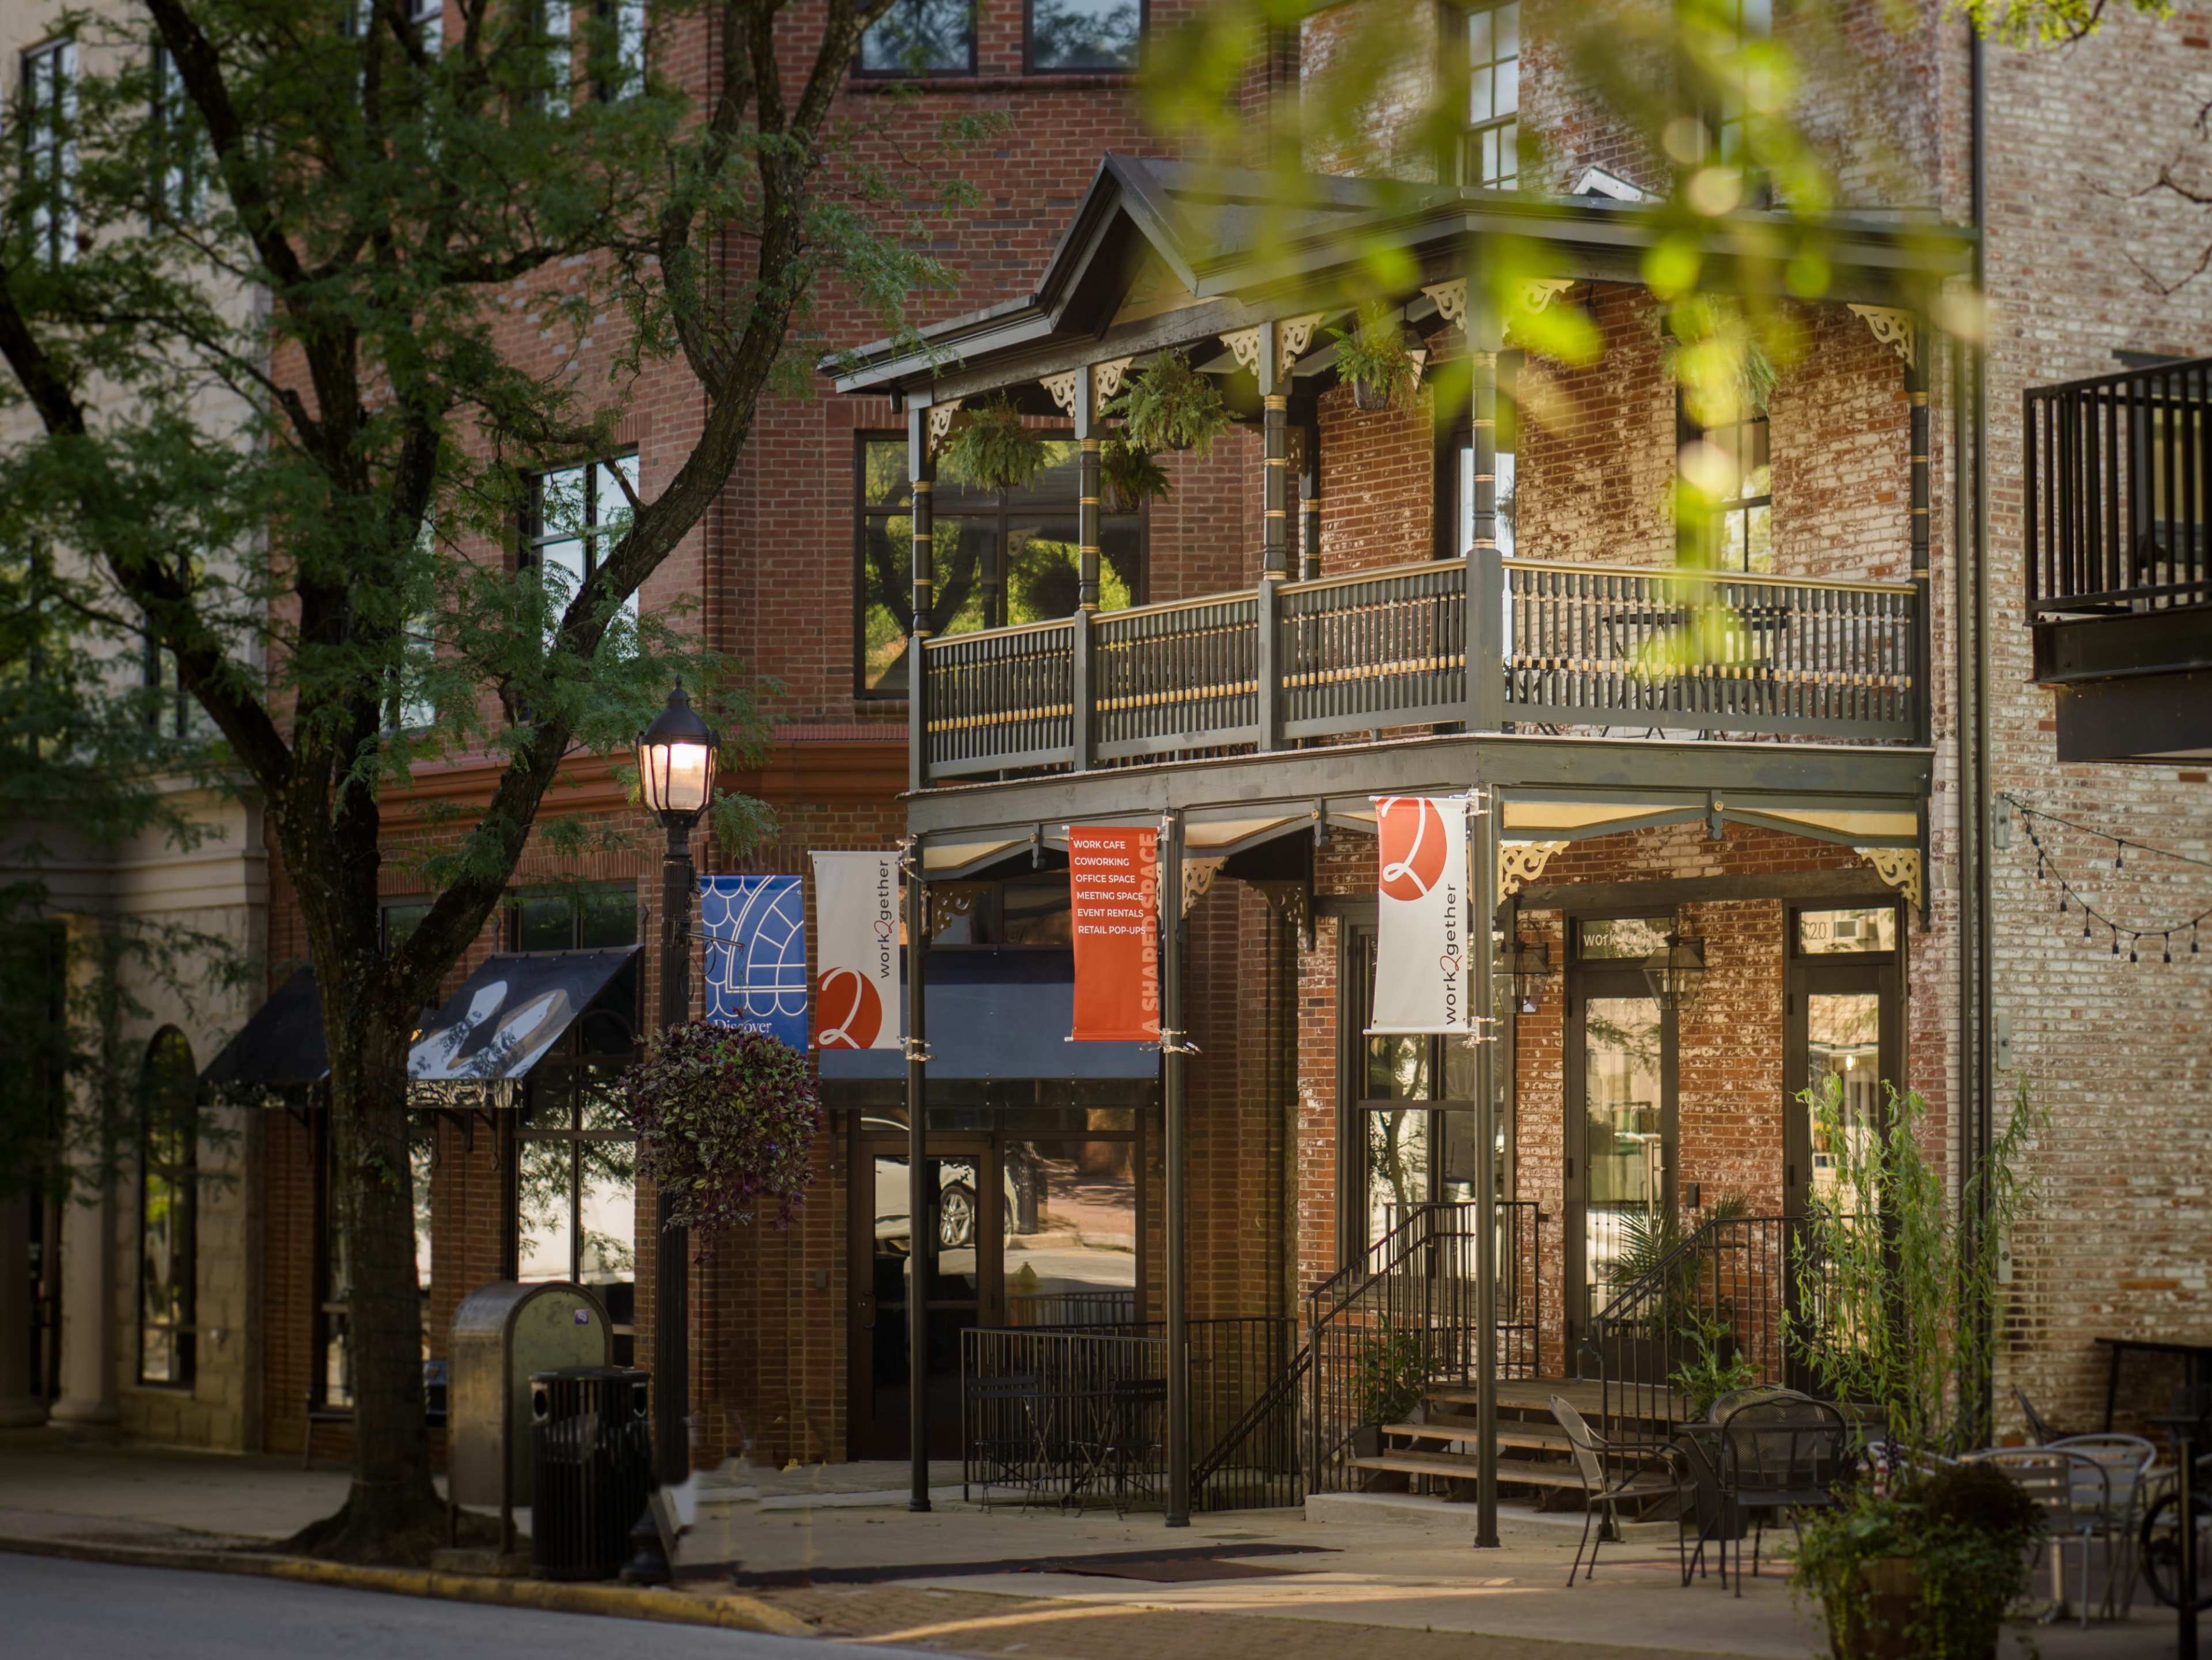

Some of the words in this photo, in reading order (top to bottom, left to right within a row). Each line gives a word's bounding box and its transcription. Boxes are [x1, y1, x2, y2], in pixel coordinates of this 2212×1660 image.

[1073, 840, 1101, 849] WORK
[1103, 841, 1126, 849] CAFE
[1074, 857, 1130, 866] COWORKING
[1138, 833, 1158, 909] SPACE
[1075, 874, 1107, 883] OFFICE
[1108, 875, 1136, 883] SPACE
[1076, 891, 1115, 900] MEETING
[1116, 893, 1143, 901] SPACE
[1077, 908, 1105, 917] EVENT
[1107, 909, 1144, 918] RENTALS
[874, 859, 895, 979] work2gether
[1078, 925, 1108, 934] RETAIL
[1109, 927, 1146, 935] POP-UPS
[1440, 884, 1463, 1025] work2gether
[1141, 915, 1159, 1011] SHARED
[1142, 1019, 1160, 1034] A
